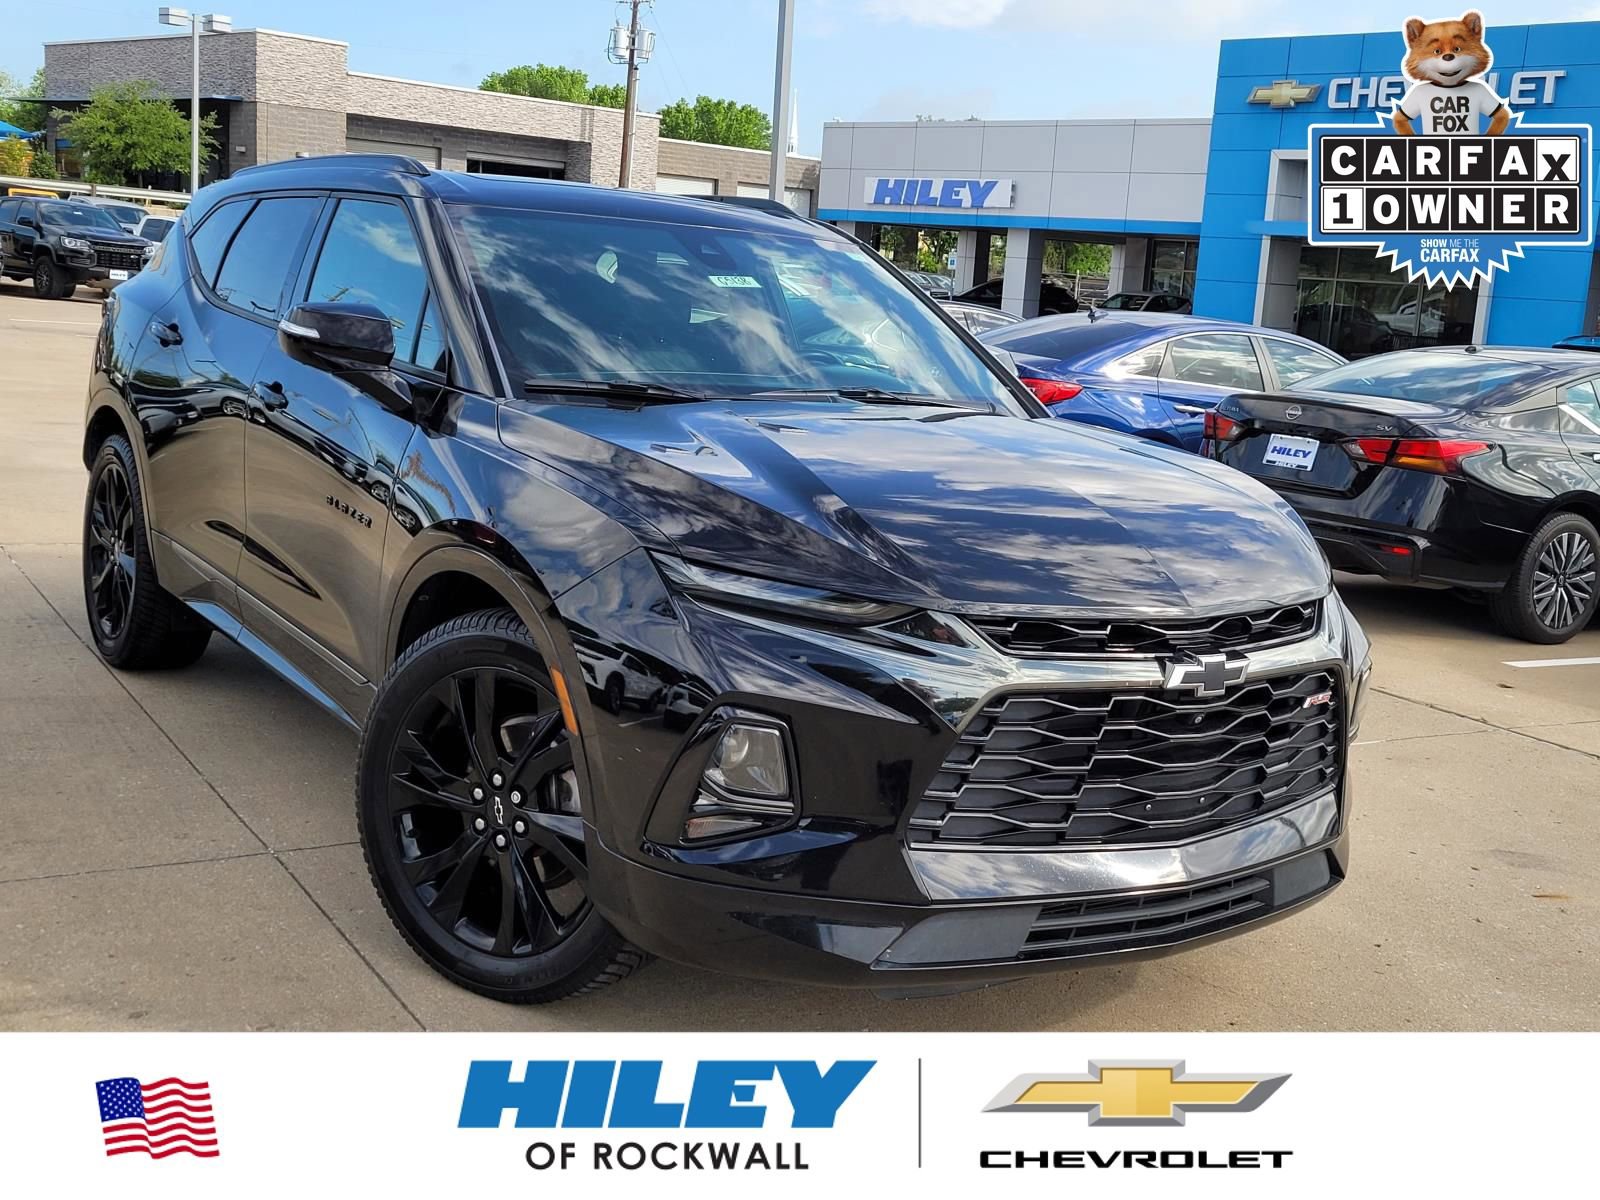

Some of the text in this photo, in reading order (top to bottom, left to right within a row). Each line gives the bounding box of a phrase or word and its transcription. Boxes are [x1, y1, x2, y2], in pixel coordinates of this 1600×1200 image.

[872, 178, 1000, 209] HILEY
[1270, 445, 1312, 459] HILEY
[326, 495, 372, 529] BLAZER
